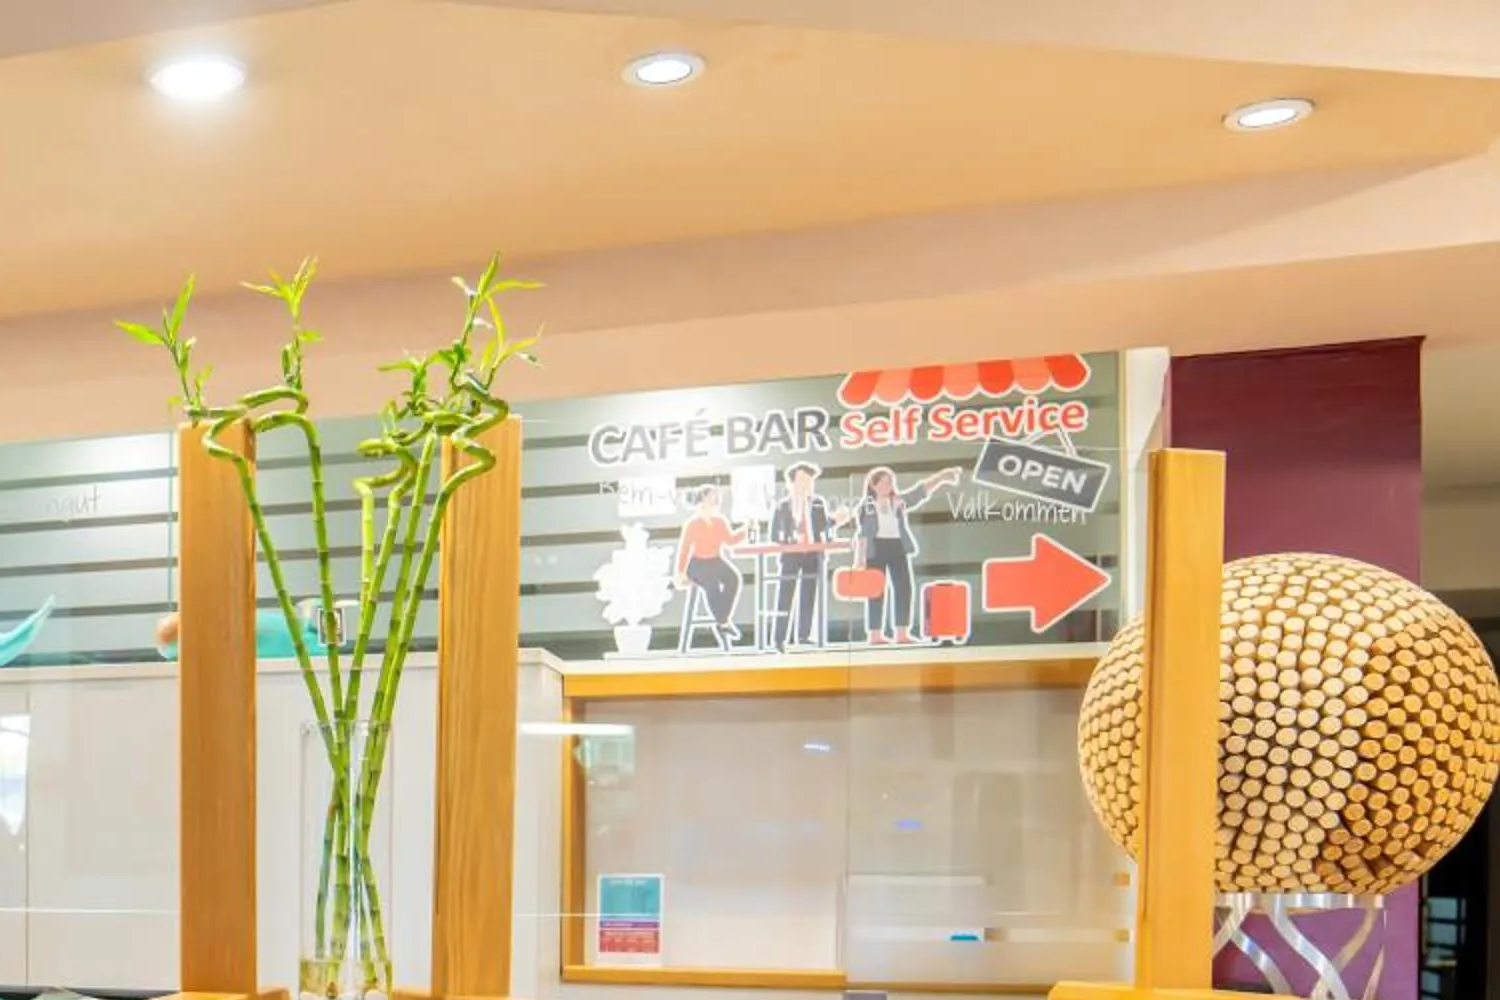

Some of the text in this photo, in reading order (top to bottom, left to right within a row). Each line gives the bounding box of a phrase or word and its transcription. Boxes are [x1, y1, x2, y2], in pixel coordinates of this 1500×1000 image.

[589, 407, 830, 465] CAFÉ BAR
[841, 396, 1087, 447] Self Service
[997, 454, 1087, 495] OPEN
